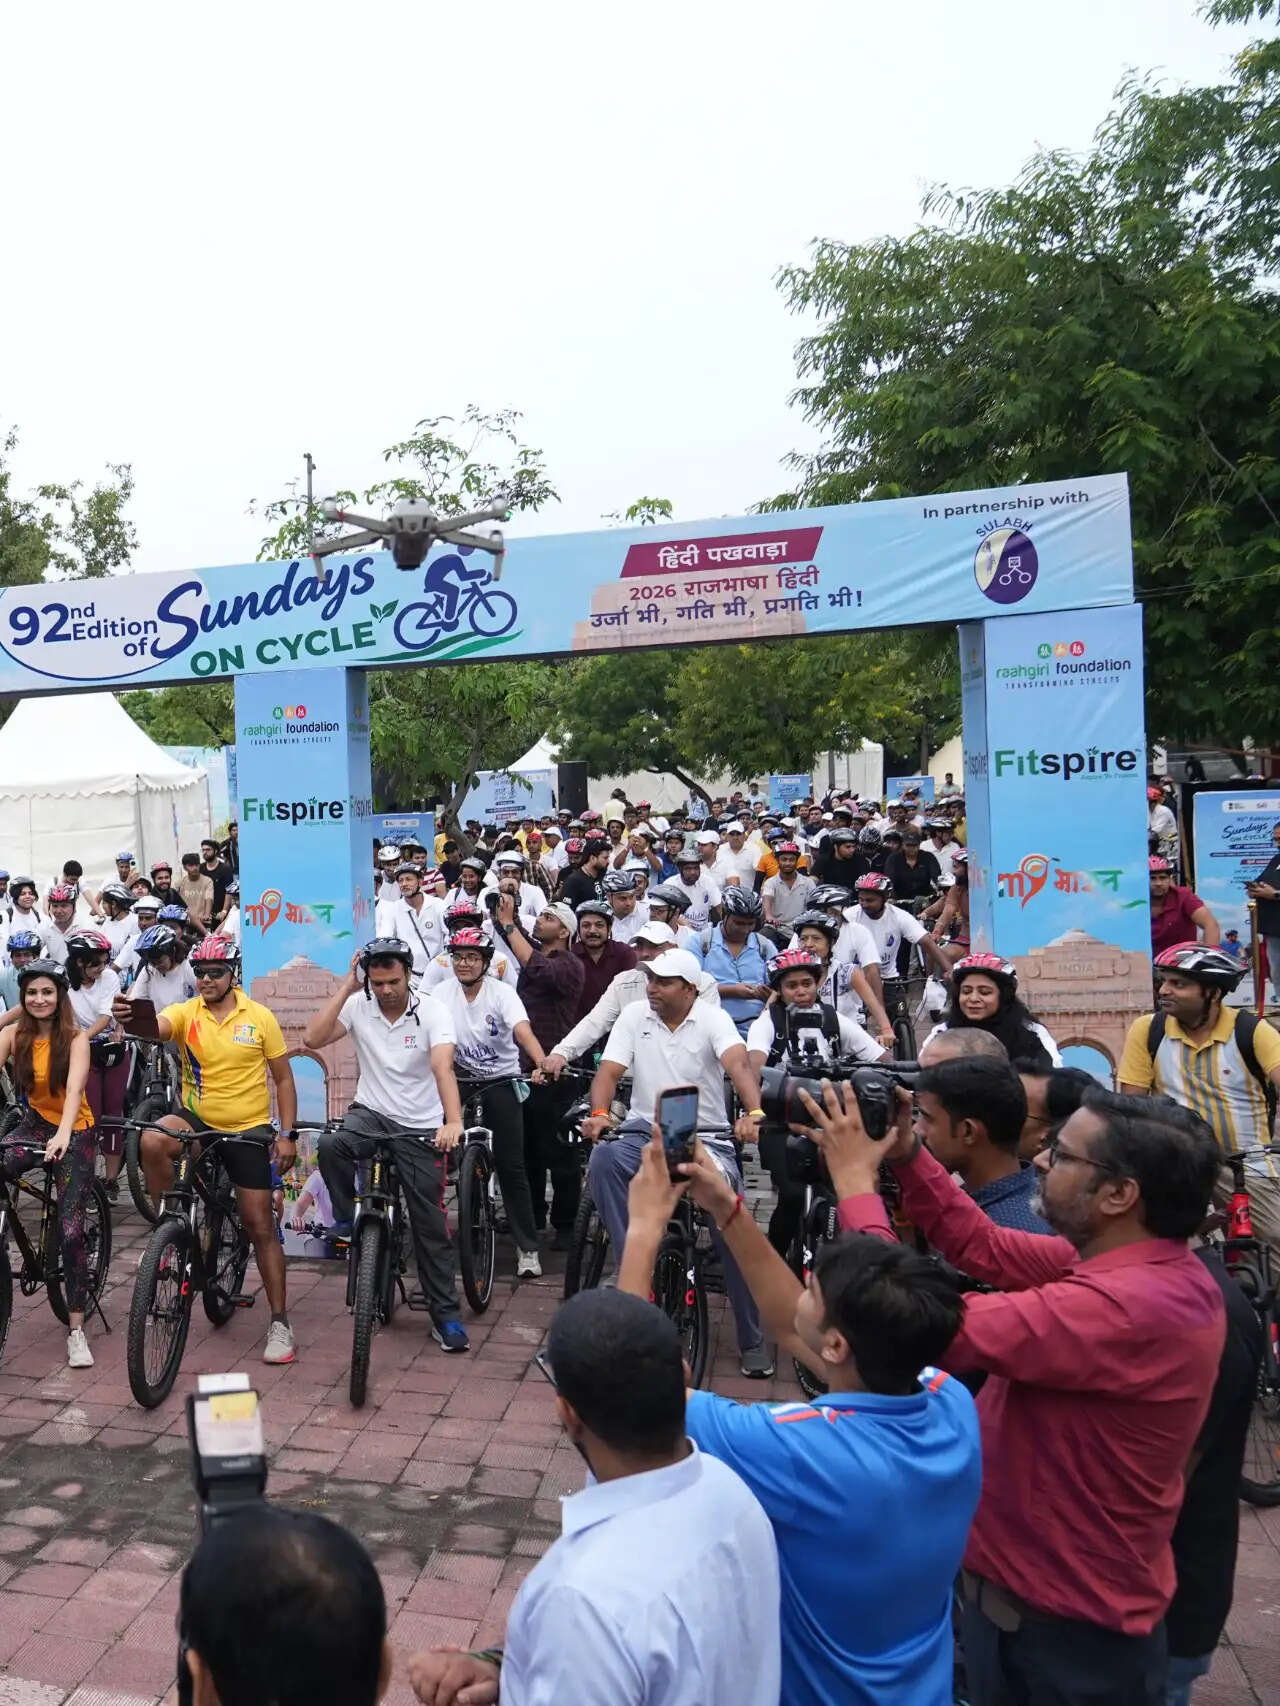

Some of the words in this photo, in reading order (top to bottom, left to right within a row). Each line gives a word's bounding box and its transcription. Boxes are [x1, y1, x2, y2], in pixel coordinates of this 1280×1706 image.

[923, 507, 939, 519] In
[944, 497, 1045, 519] partnership
[1049, 490, 1089, 506] with
[975, 517, 1033, 538] SULABH
[657, 544, 699, 568] हिंदी
[706, 541, 788, 562] पखवाड़ा
[630, 584, 677, 601] 2026
[684, 575, 768, 596] राजभाषा
[776, 565, 820, 589] हिंदी
[150, 556, 375, 659] Sundays
[676, 600, 714, 621] गति
[763, 590, 819, 614] प्रगति
[73, 617, 158, 641] Edition
[123, 637, 148, 657] of
[190, 645, 245, 676] ON
[256, 621, 376, 663] CYCLE
[996, 663, 1050, 681] raahgiri
[1056, 658, 1132, 675] foundation
[243, 724, 282, 738] raahgiri
[286, 721, 339, 734] foundation
[994, 747, 1137, 780] Fitspire
[243, 797, 345, 826] Fitspire
[1222, 822, 1268, 839] Sundays
